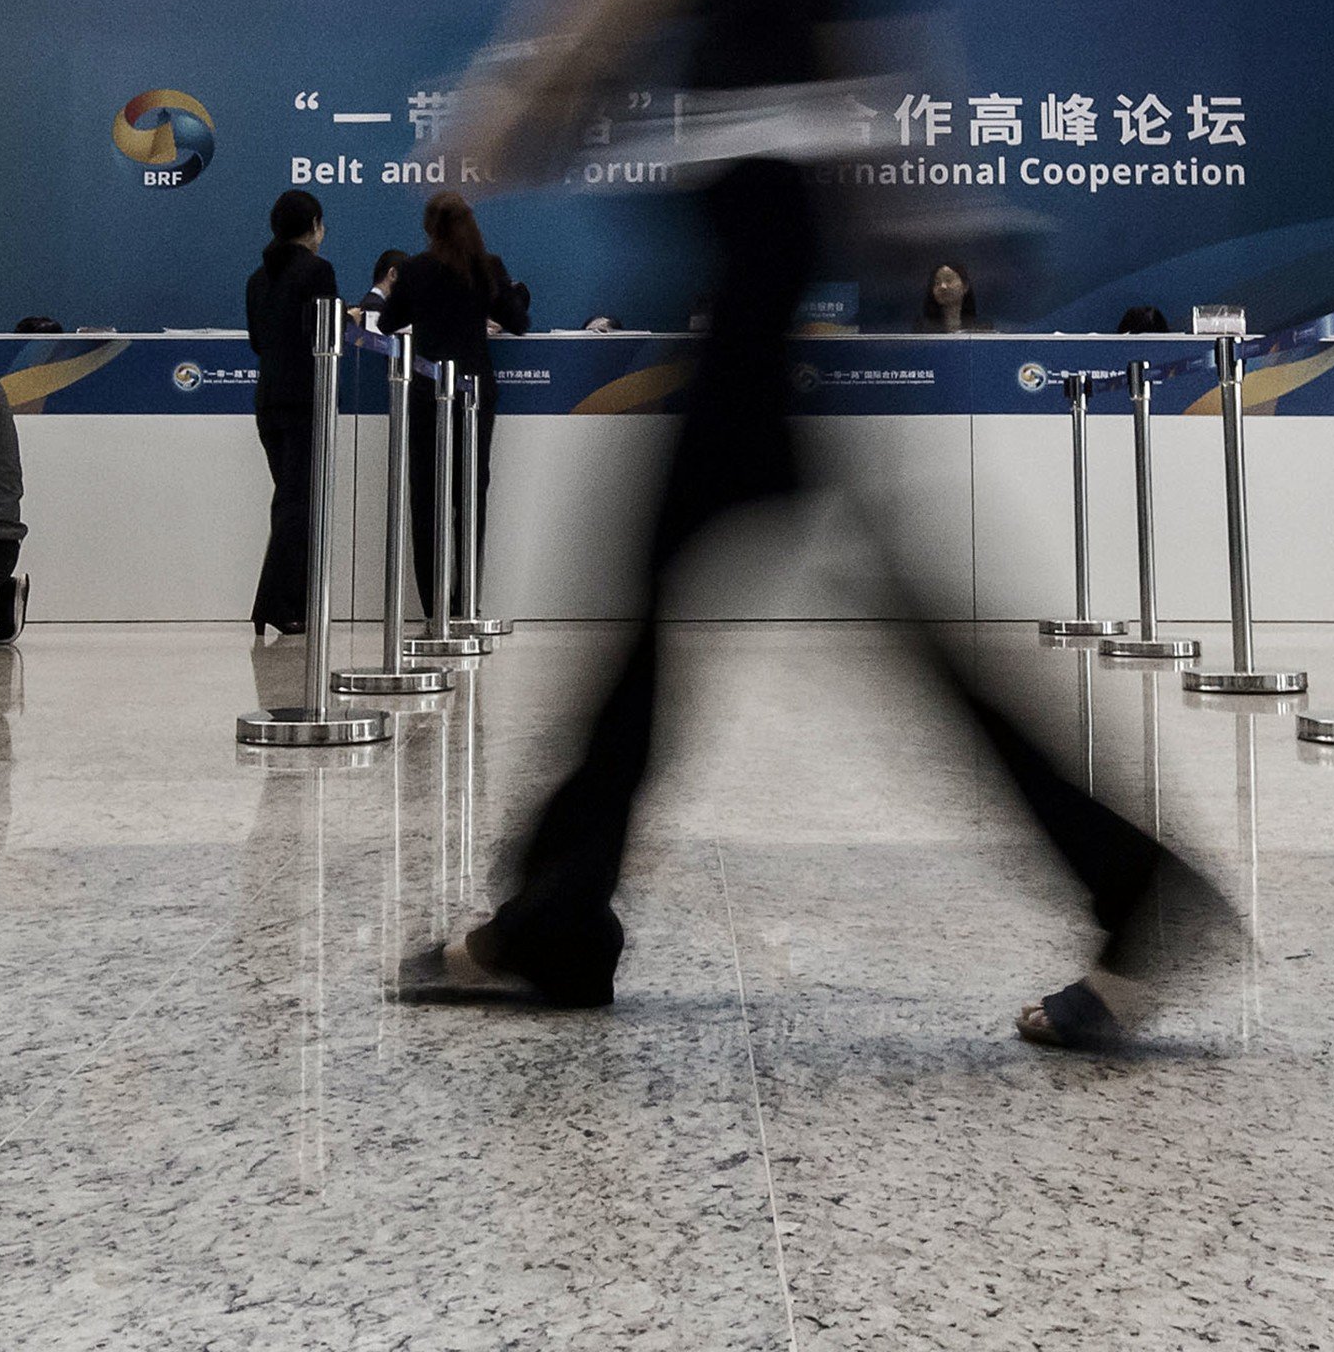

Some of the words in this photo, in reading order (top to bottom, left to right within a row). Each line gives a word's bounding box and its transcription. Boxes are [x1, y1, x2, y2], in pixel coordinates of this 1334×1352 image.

[143, 171, 183, 187] BRF
[291, 156, 364, 185] Belt
[381, 156, 445, 184] and
[1020, 157, 1246, 192] Cooperation
